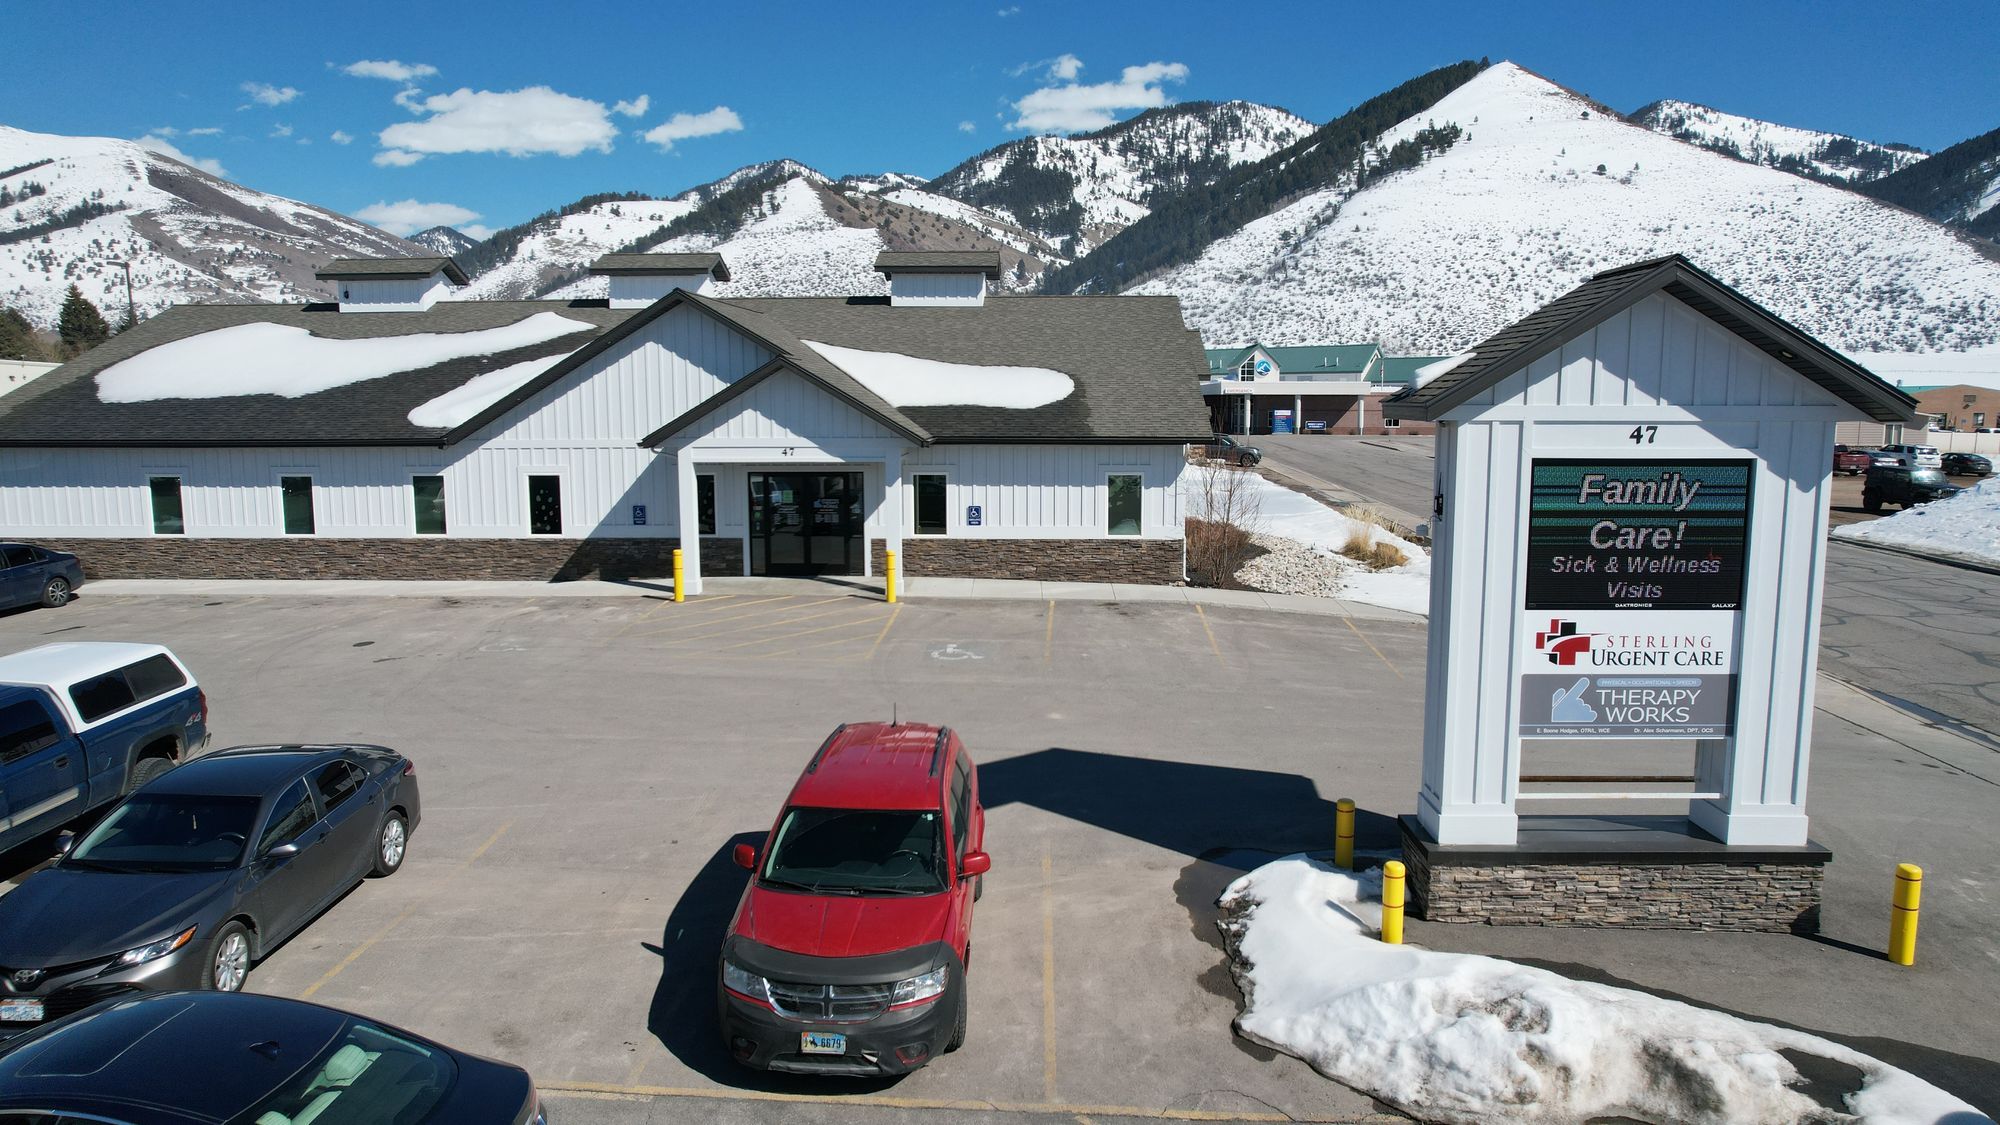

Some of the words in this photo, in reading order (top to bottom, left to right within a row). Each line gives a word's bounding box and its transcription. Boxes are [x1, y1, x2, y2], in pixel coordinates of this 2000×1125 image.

[1629, 425, 1658, 444] 47
[781, 447, 794, 456] 47
[1577, 472, 1701, 512] Family
[1590, 520, 1688, 550] Care!
[1551, 556, 1597, 573] Sick
[1604, 556, 1619, 573] &
[1627, 556, 1721, 573] Wellness
[1607, 581, 1663, 598] Visits
[1607, 635, 1712, 648] STERLING
[1591, 649, 1670, 666] URGENT
[1674, 651, 1724, 666] CARE
[1596, 689, 1702, 705] THERAPY
[1605, 706, 1690, 723] WORKS
[821, 1038, 841, 1048] 6679
